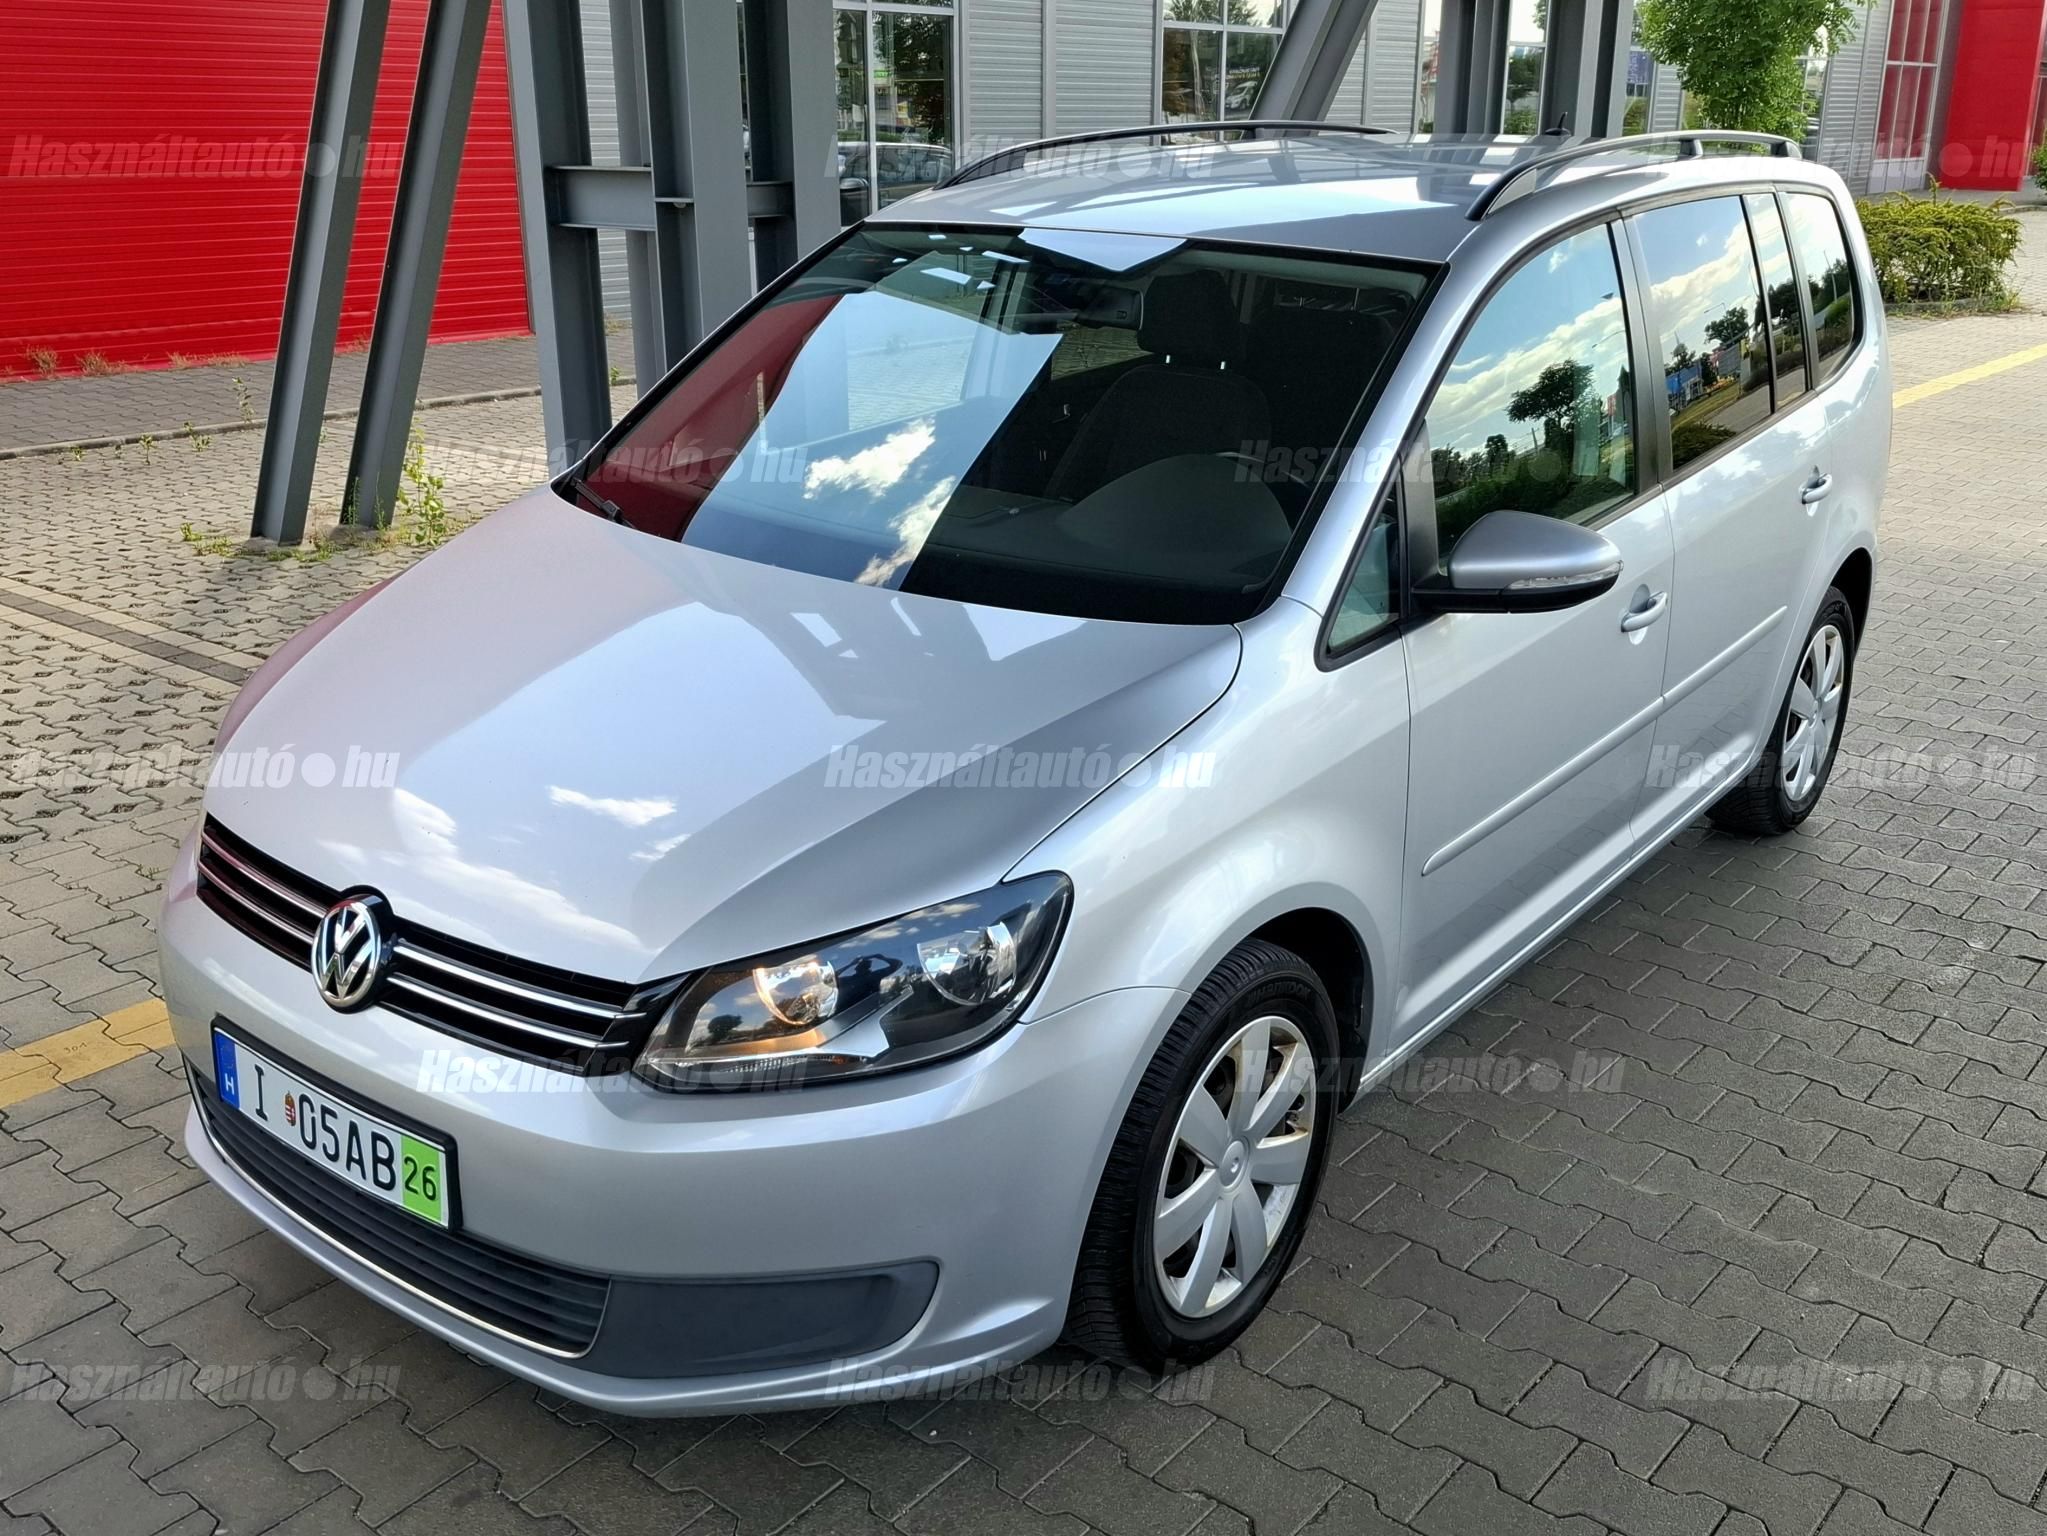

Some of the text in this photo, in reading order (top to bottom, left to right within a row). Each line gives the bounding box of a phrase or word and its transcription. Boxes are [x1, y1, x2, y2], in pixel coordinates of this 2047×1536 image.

[225, 1076, 235, 1095] H
[298, 1093, 396, 1192] 05AB
[403, 1156, 437, 1201] 26
